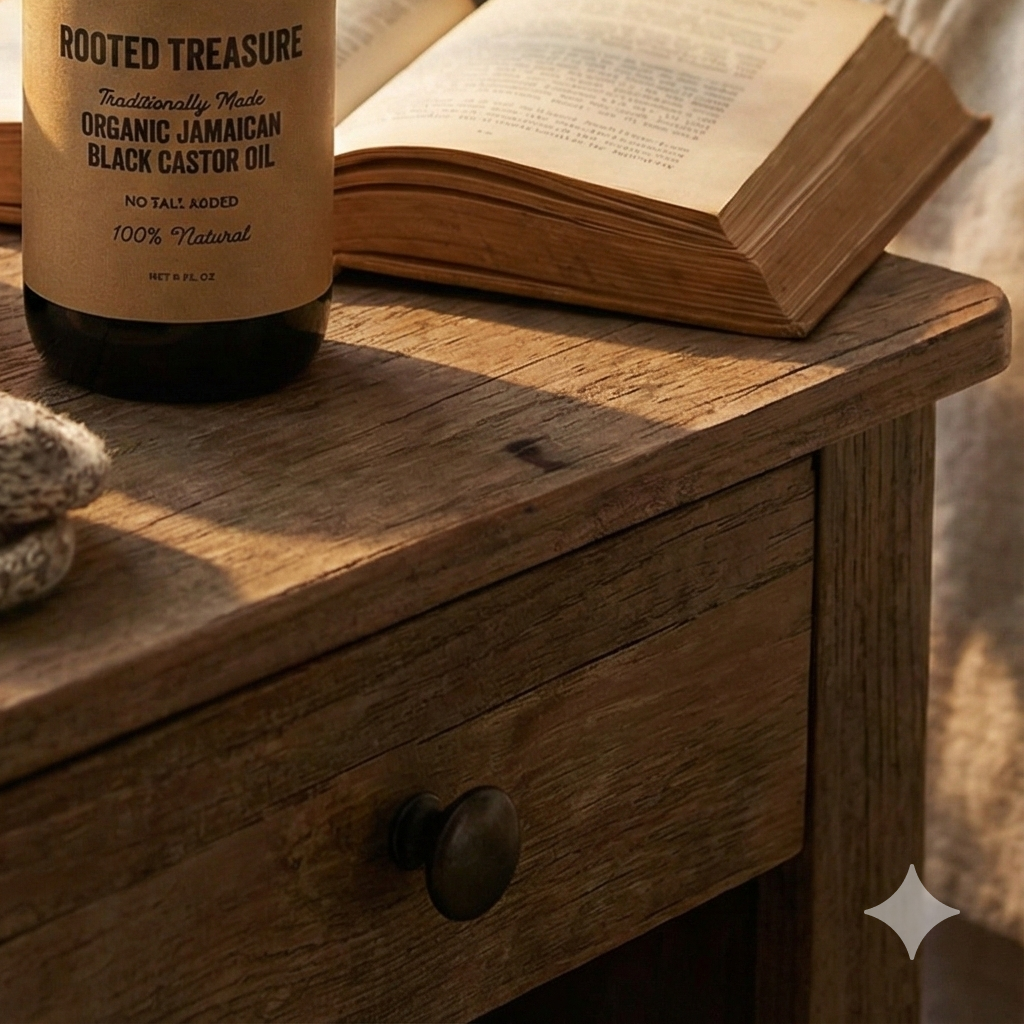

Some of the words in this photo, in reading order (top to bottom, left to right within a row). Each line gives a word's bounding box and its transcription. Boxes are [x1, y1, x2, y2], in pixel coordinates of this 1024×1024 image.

[60, 24, 160, 70] ROOTED
[167, 24, 303, 71] TREASURE
[98, 87, 211, 117] Traditionally
[216, 89, 266, 110] Made
[81, 111, 170, 144] ORGANIC
[176, 111, 281, 144] JAMAICAN
[88, 142, 152, 173] BLACK
[158, 147, 239, 174] CASTOR
[245, 143, 275, 171] OIL
[125, 194, 147, 208] NO
[112, 225, 162, 246] 100%
[171, 224, 252, 246] Natural
